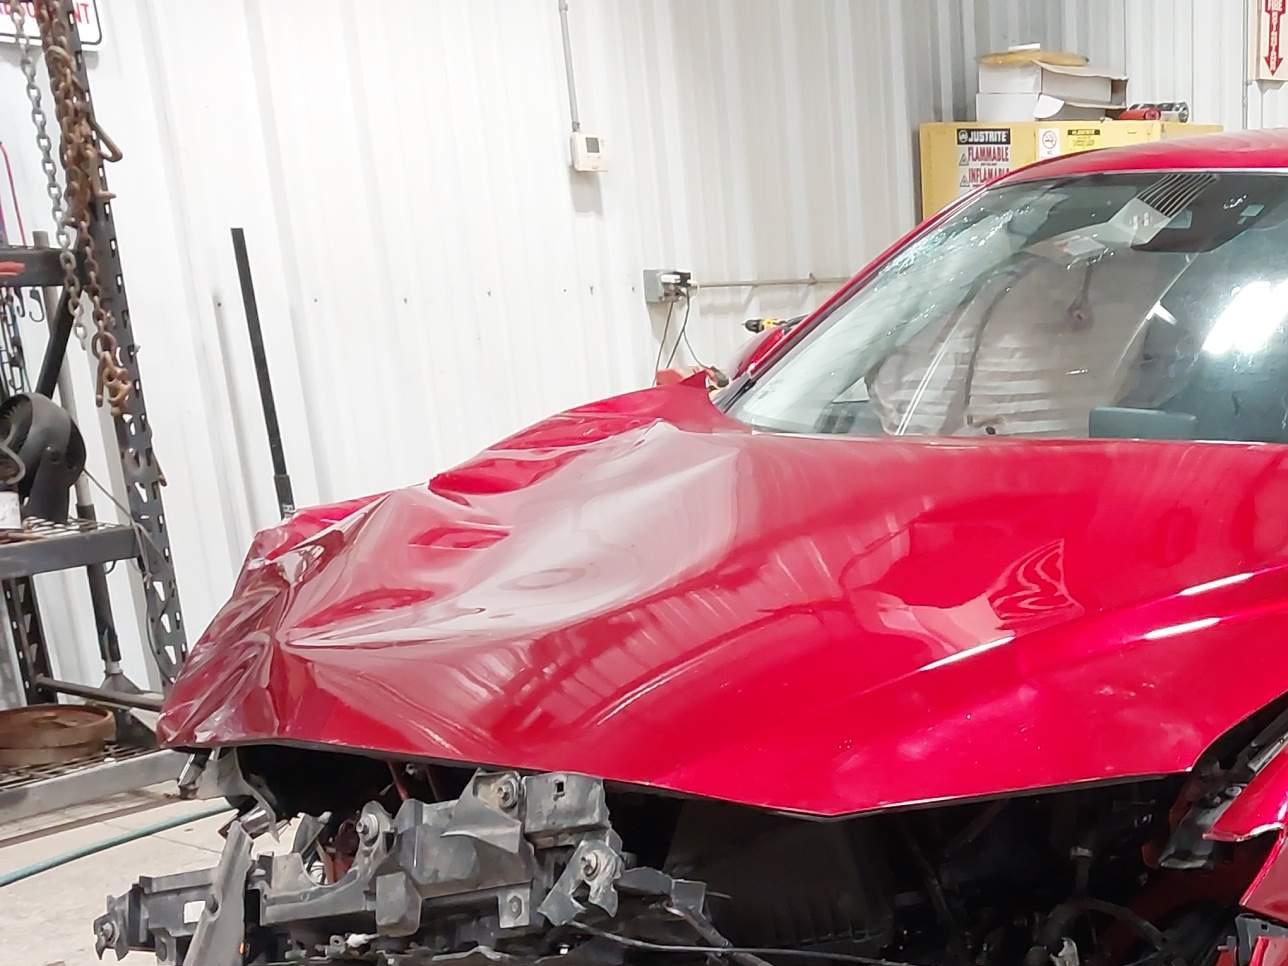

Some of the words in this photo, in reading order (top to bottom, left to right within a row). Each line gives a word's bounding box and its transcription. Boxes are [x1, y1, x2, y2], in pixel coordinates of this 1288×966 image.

[968, 130, 1008, 143] JUSTRITE
[967, 146, 1009, 162] FLAMMABLE
[968, 167, 1010, 183] INFLAMAB
